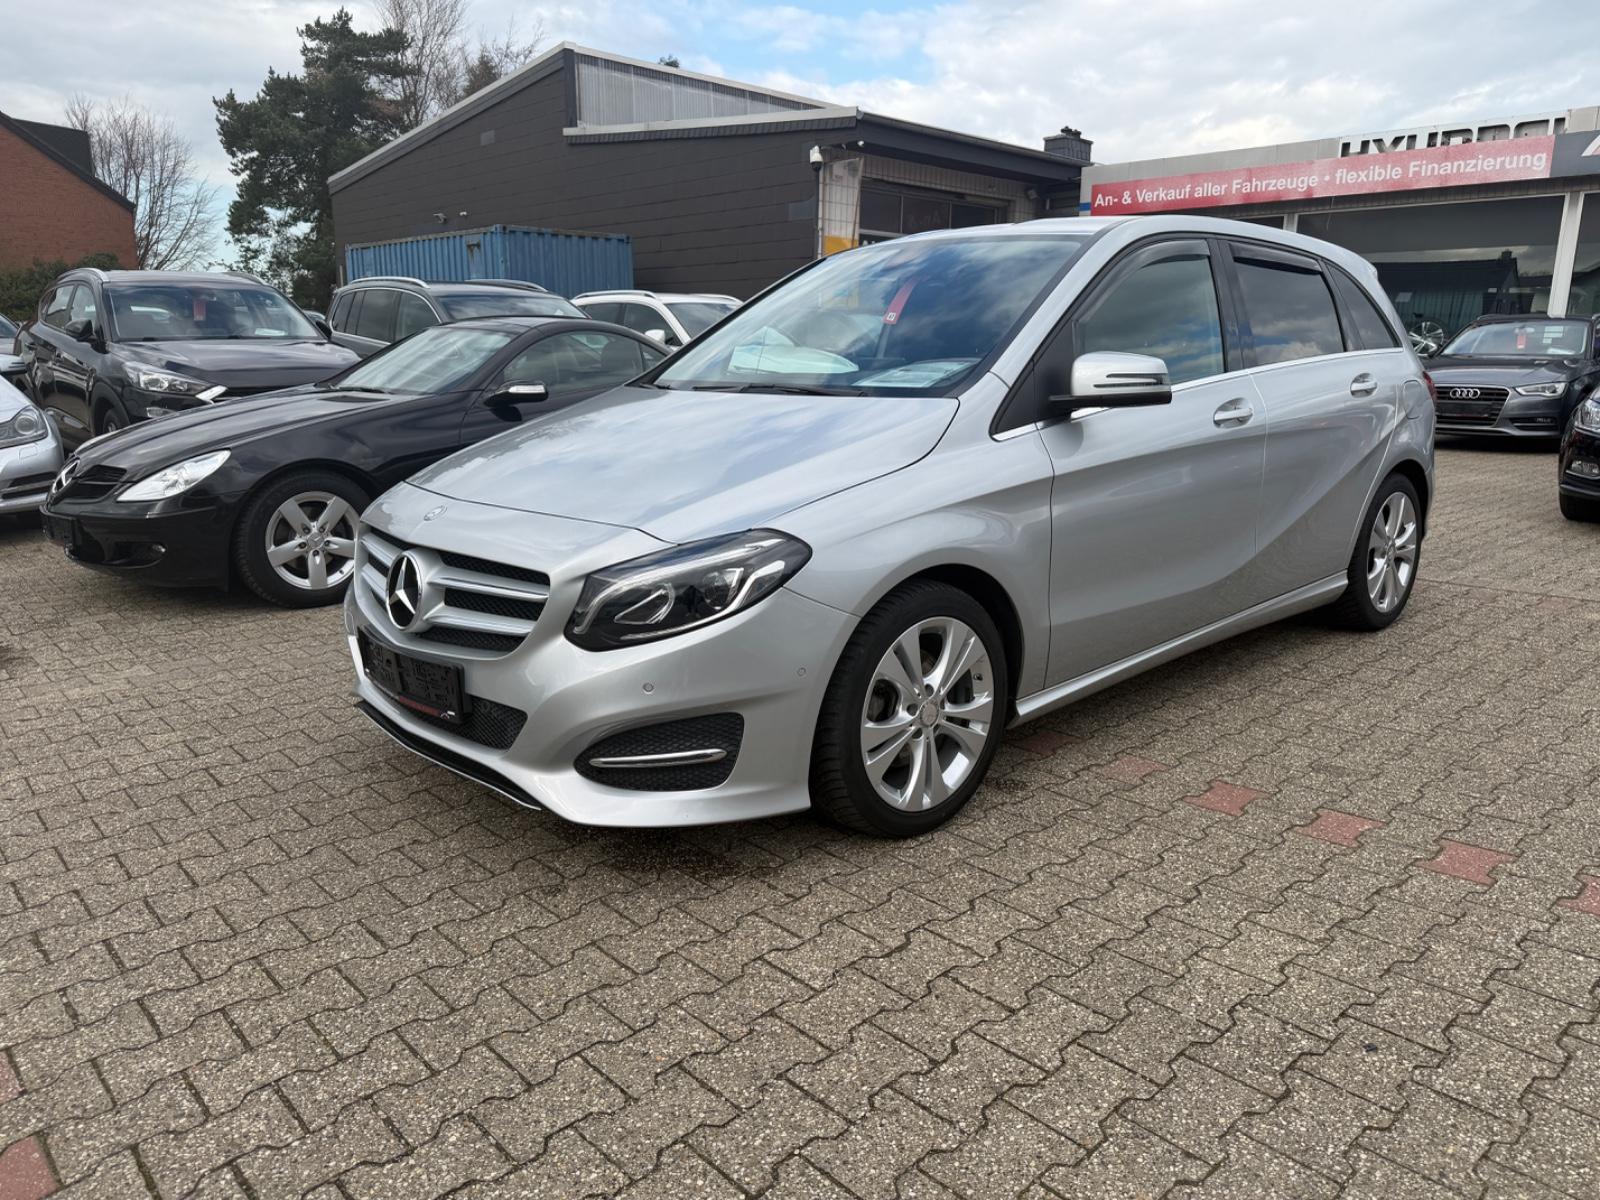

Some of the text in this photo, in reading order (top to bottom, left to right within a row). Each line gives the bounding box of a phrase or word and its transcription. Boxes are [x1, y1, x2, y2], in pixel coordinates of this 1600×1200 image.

[1094, 194, 1118, 208] An-
[1121, 191, 1132, 205] &
[1136, 184, 1191, 204] Verkauf
[1194, 182, 1228, 197] aller
[1231, 174, 1318, 194] Fahrzeuge
[1335, 163, 1402, 185] flexible
[1408, 151, 1547, 179] Finanzierung
